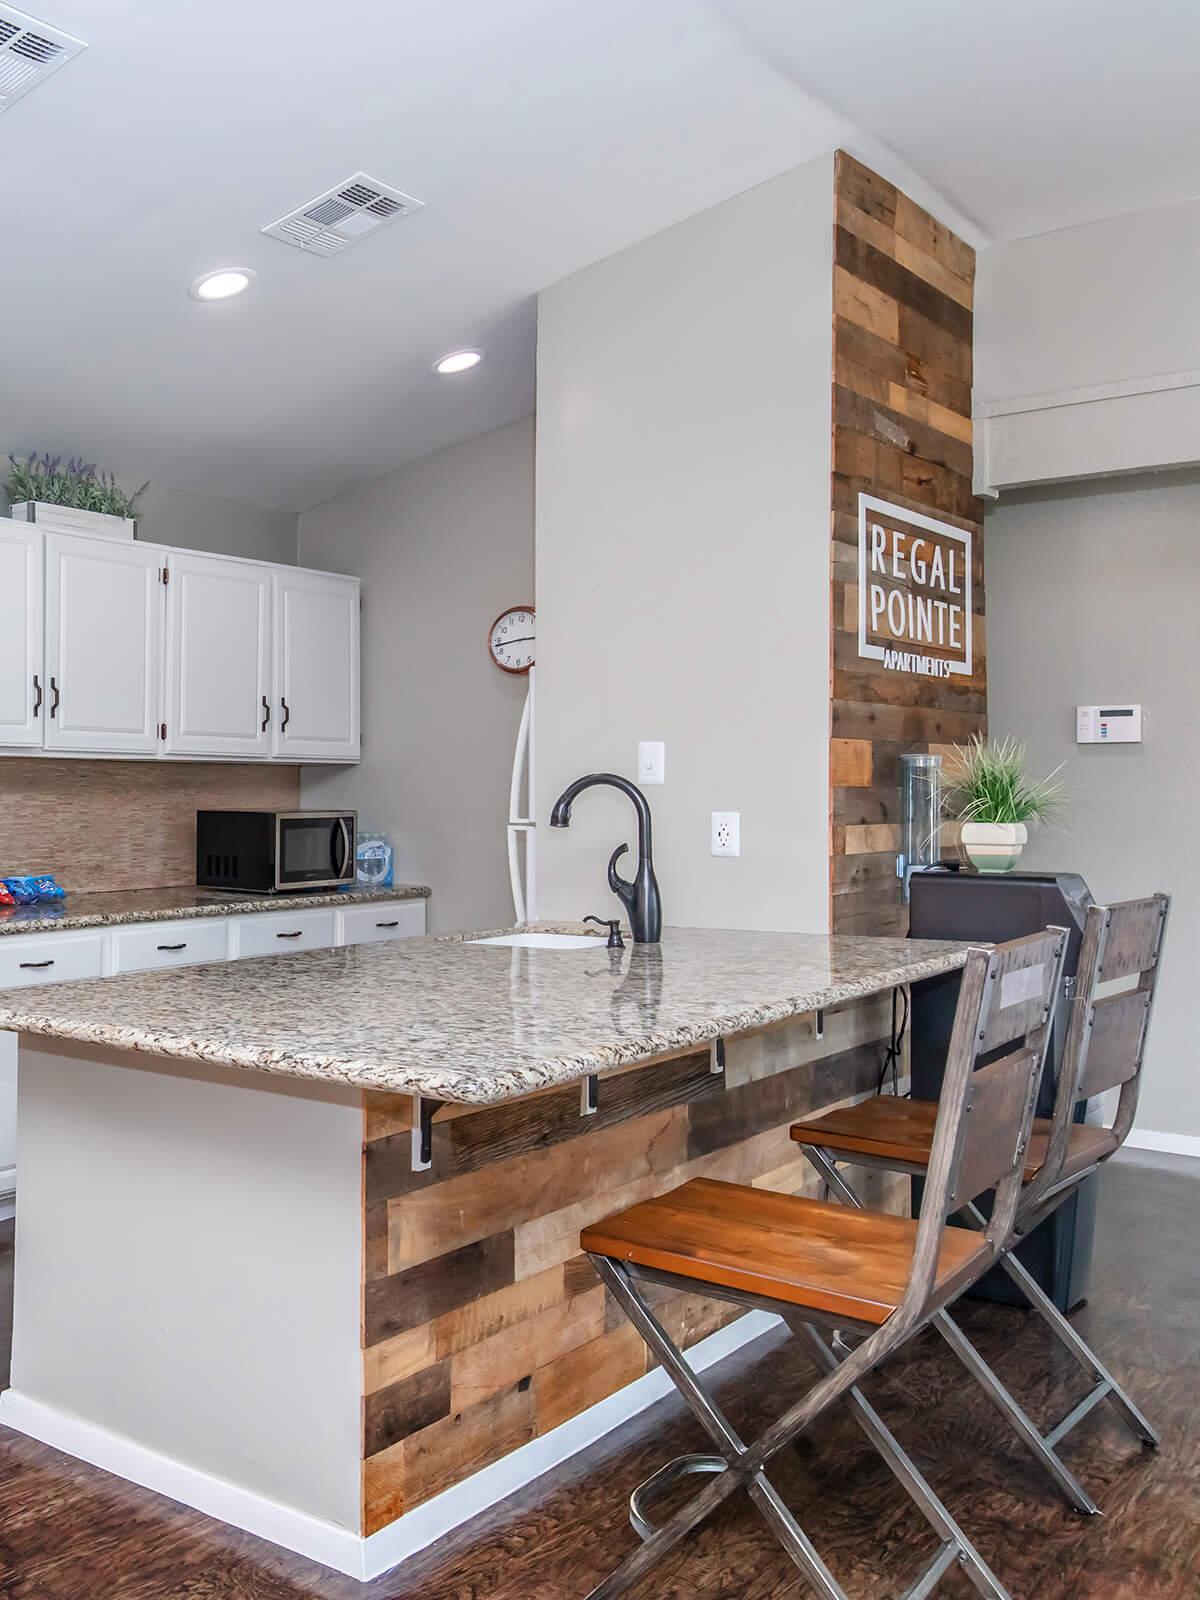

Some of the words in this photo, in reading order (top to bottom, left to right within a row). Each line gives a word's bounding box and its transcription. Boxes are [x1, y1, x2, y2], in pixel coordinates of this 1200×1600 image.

[871, 524, 961, 594] REGAL
[870, 584, 962, 649] POINTE
[883, 649, 950, 678] APARTMENTS
